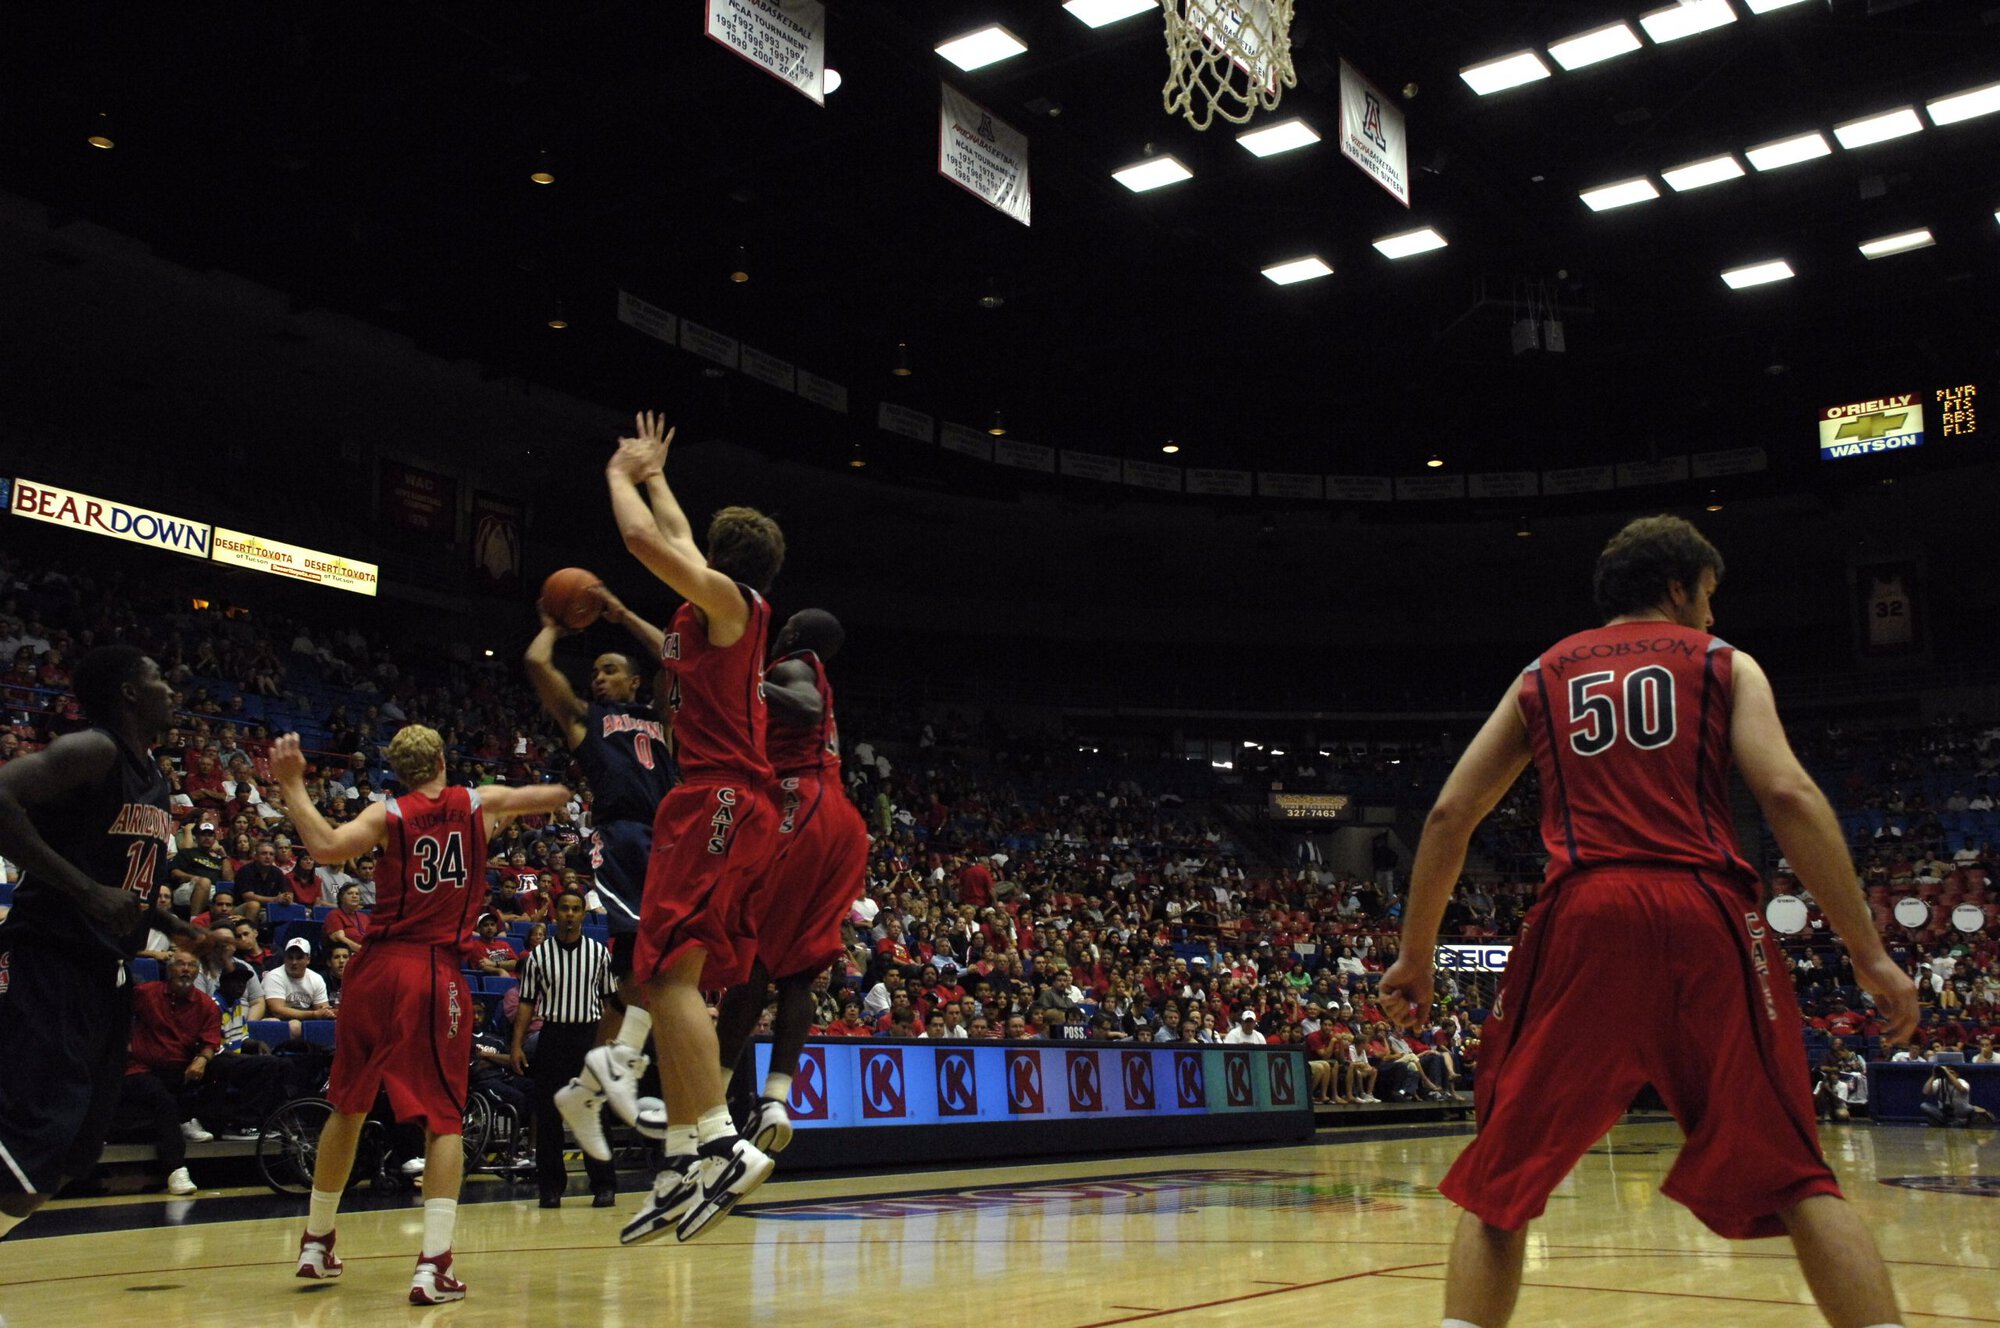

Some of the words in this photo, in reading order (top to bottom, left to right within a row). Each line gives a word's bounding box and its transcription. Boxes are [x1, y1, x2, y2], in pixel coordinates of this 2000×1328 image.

[716, 14, 736, 34] 1995
[743, 31, 764, 50] 1996
[769, 48, 789, 65] 1997
[733, 14, 754, 34] 1992
[760, 31, 780, 49] 1993
[726, 31, 747, 50] 1999
[753, 48, 774, 66] 2000
[1361, 154, 1379, 175] SWEET
[1380, 170, 1404, 195] SIXTEEN
[1827, 394, 1912, 419] O'RIELLY
[1942, 409, 1975, 424] RBS
[1943, 397, 1972, 412] PTS
[1830, 434, 1916, 458] WATSON
[214, 537, 253, 555] DESERT
[255, 547, 293, 564] TOYOTA
[245, 554, 269, 565] Tucson
[304, 558, 339, 575] DESERT
[341, 567, 376, 583] TOYOTA
[332, 575, 354, 584] Tucson
[1876, 599, 1904, 618] 32
[1568, 664, 1677, 757] 50
[707, 787, 736, 855] CATS
[1287, 809, 1336, 818] 327-7463
[122, 840, 158, 900] 14
[414, 831, 467, 894] 34
[1064, 1026, 1087, 1039] POSS.
